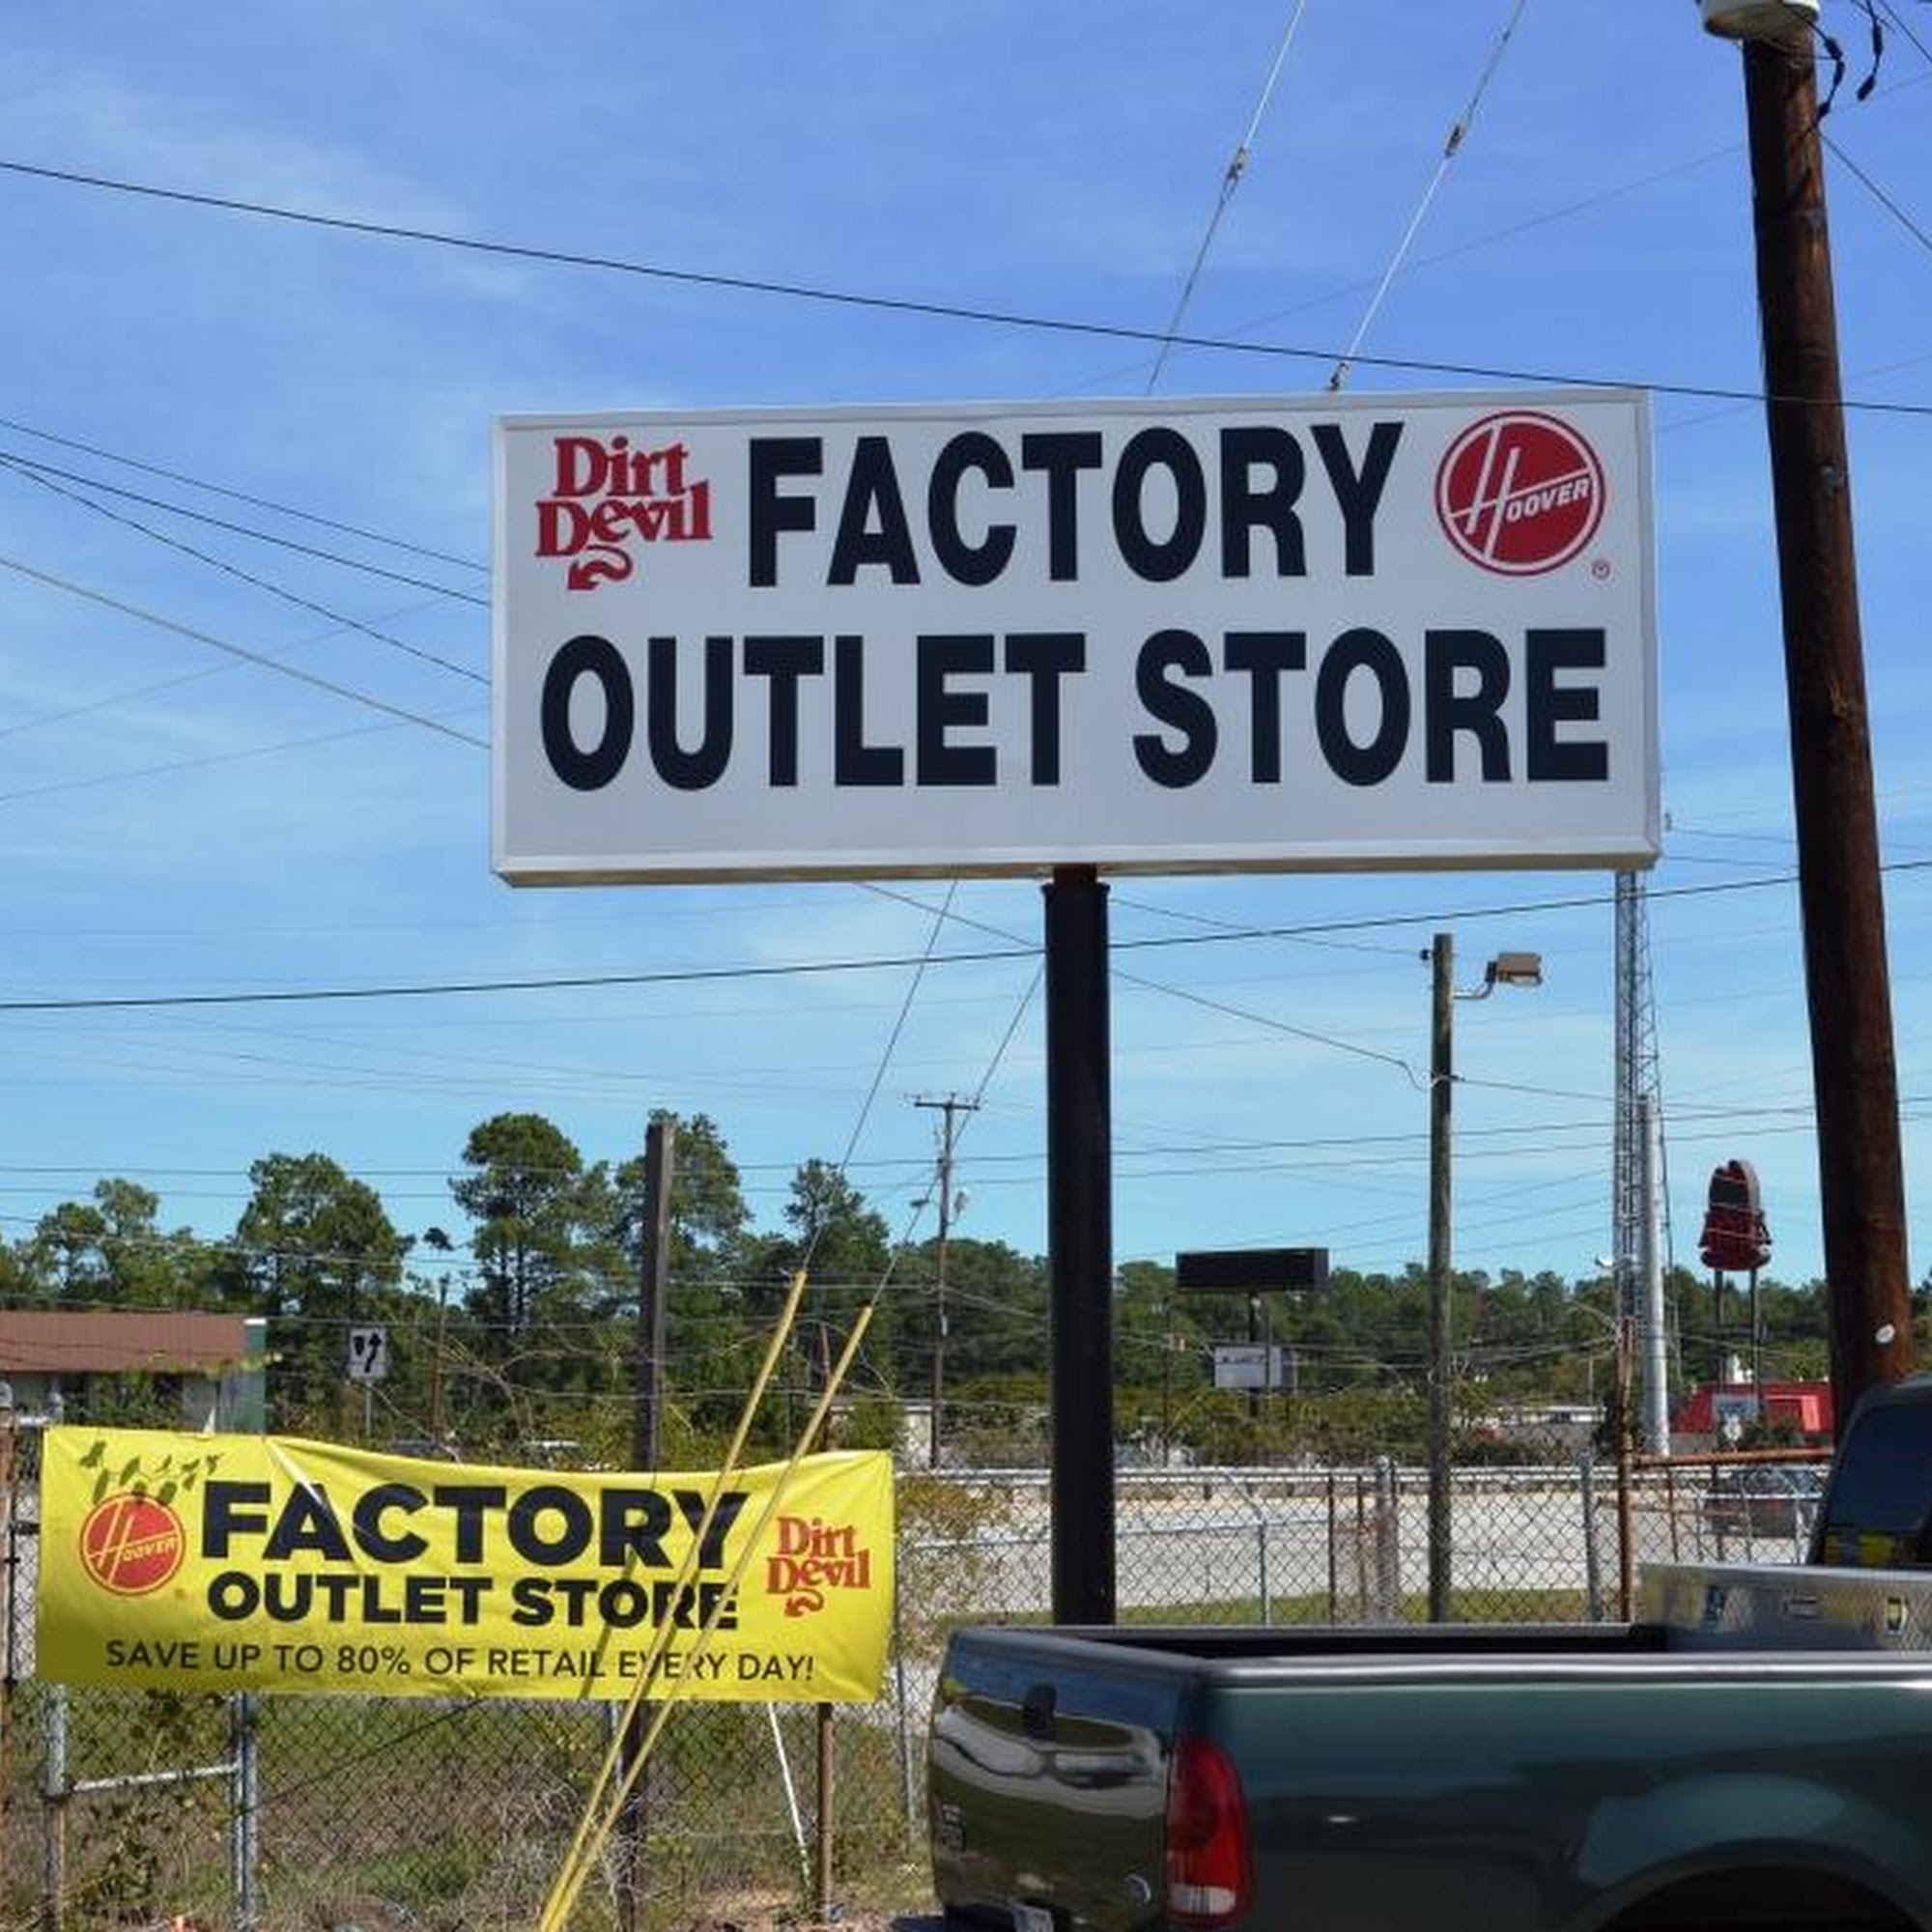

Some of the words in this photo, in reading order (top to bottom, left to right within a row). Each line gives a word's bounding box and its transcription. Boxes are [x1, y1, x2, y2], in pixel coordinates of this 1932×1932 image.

[553, 436, 689, 497] Dirt
[1448, 421, 1592, 560] HOOVER
[535, 479, 713, 557] Devil
[749, 422, 1405, 588] FACTORY
[541, 632, 1086, 792] OUTLET
[1132, 627, 1609, 789] STORE
[202, 1480, 750, 1570] FACTORY
[777, 1516, 858, 1558] Dirt
[207, 1571, 494, 1625] OUTLET
[511, 1577, 738, 1630] STORE
[766, 1548, 871, 1595] Devil
[106, 1640, 199, 1670] SAVE
[213, 1644, 261, 1671] UP
[273, 1644, 324, 1673] TO
[338, 1645, 411, 1675] 80%
[425, 1647, 477, 1675] OF
[488, 1649, 607, 1679] RETAIL
[738, 1653, 814, 1681] DAY!
